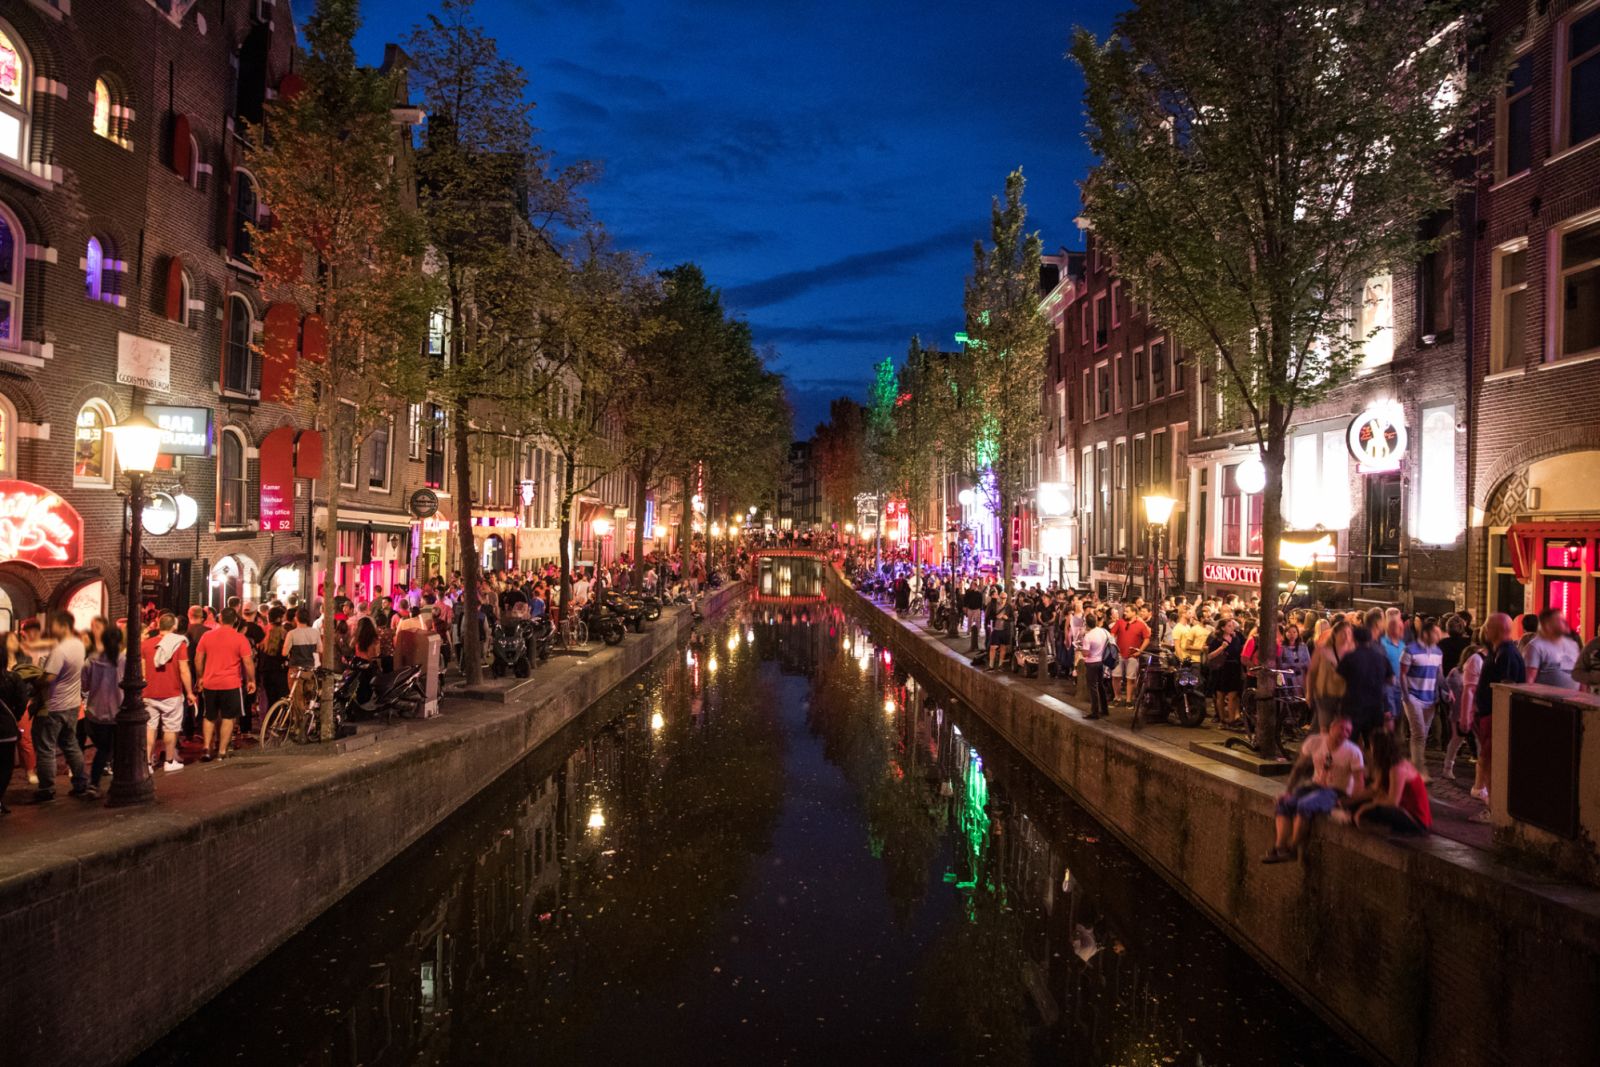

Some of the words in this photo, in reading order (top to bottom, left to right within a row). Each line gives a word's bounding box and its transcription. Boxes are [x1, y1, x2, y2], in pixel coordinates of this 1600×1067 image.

[158, 415, 193, 432] BAR
[279, 520, 290, 529] 52
[1204, 565, 1237, 581] CASINO
[1238, 567, 1262, 583] CITY
